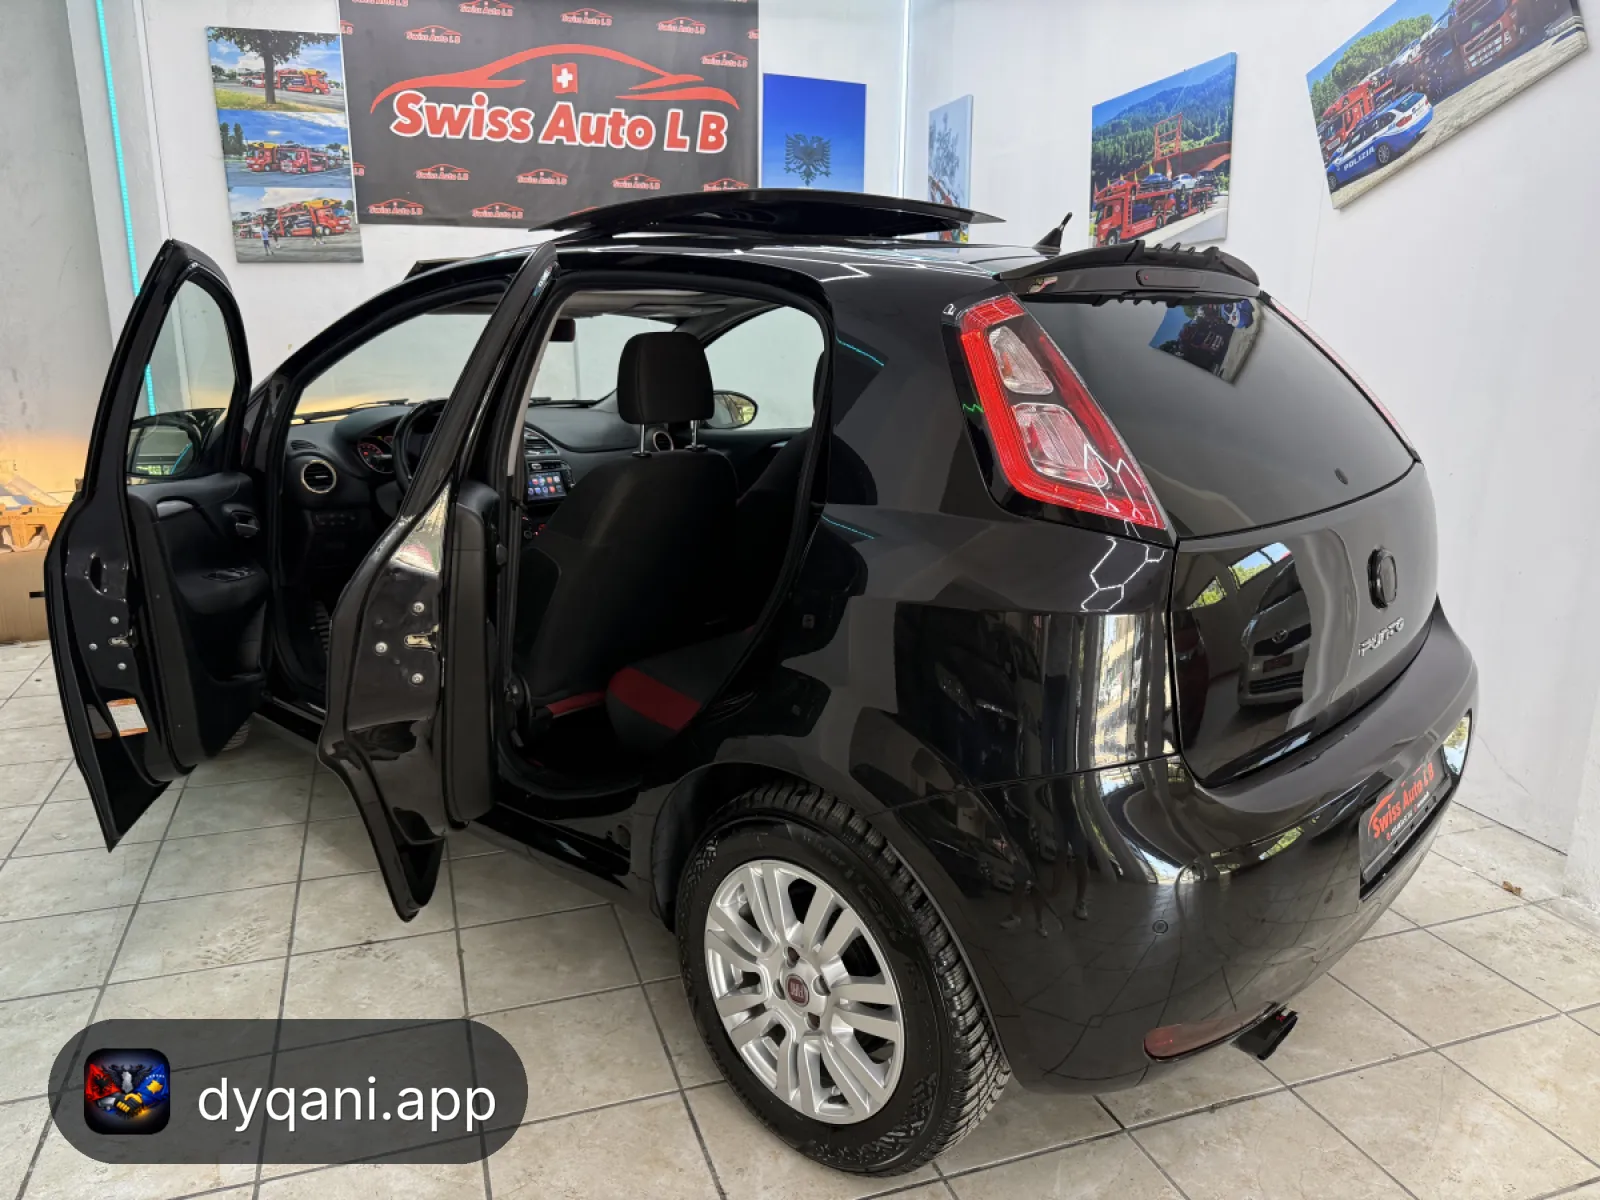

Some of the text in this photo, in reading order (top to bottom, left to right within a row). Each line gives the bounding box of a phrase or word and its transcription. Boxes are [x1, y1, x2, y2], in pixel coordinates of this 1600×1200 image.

[389, 90, 728, 154] Swiss Auto L B
[1343, 146, 1375, 171] POLIZIA
[1371, 800, 1402, 839] Swiss
[1402, 779, 1423, 810] Auto
